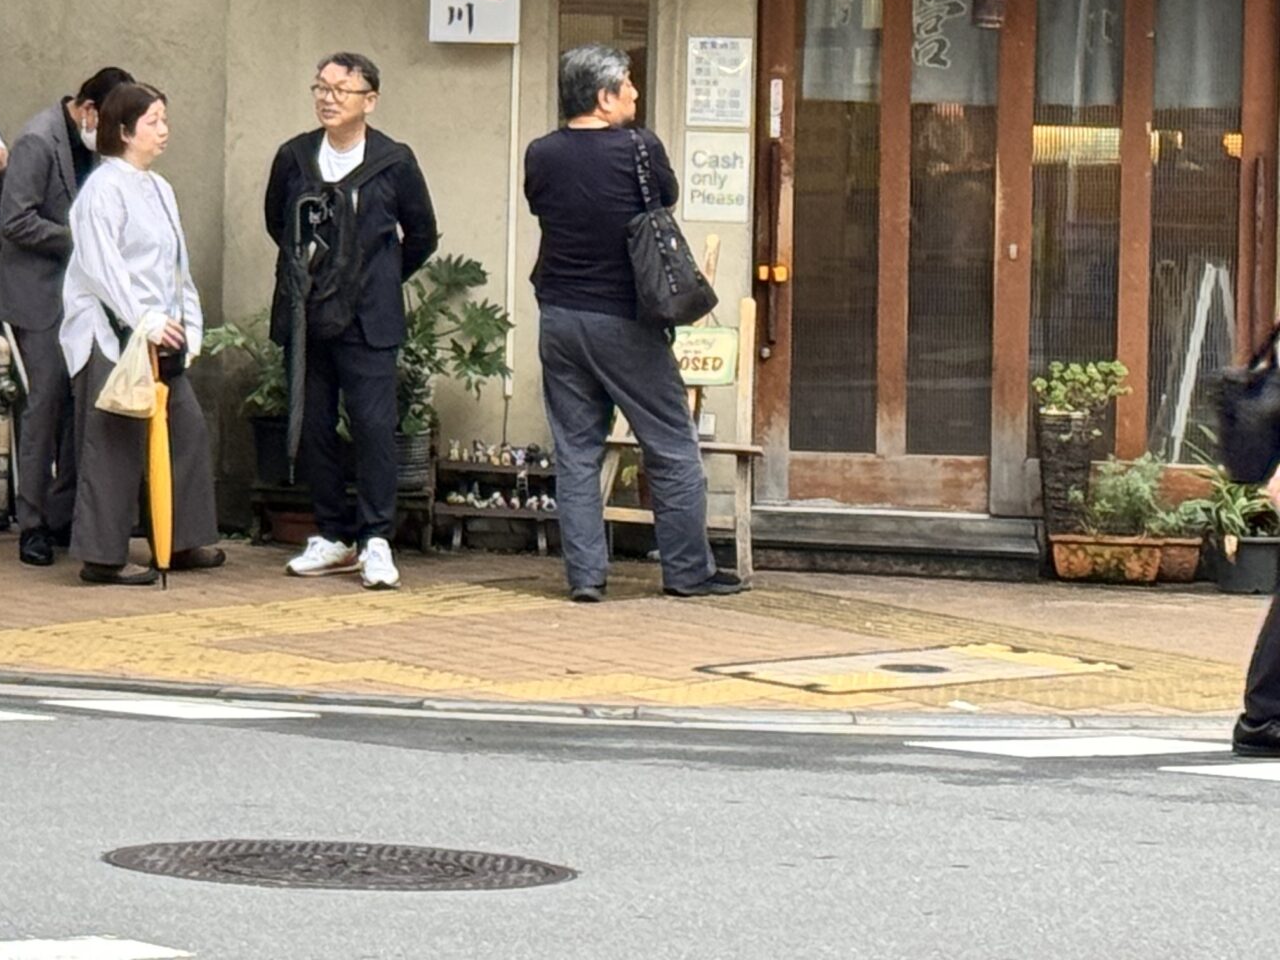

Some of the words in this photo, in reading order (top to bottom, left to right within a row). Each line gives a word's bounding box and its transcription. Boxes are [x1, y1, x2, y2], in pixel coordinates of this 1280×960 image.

[691, 150, 744, 170] Cash
[690, 168, 728, 190] only
[690, 189, 745, 207] Please
[680, 356, 723, 372] OSED
